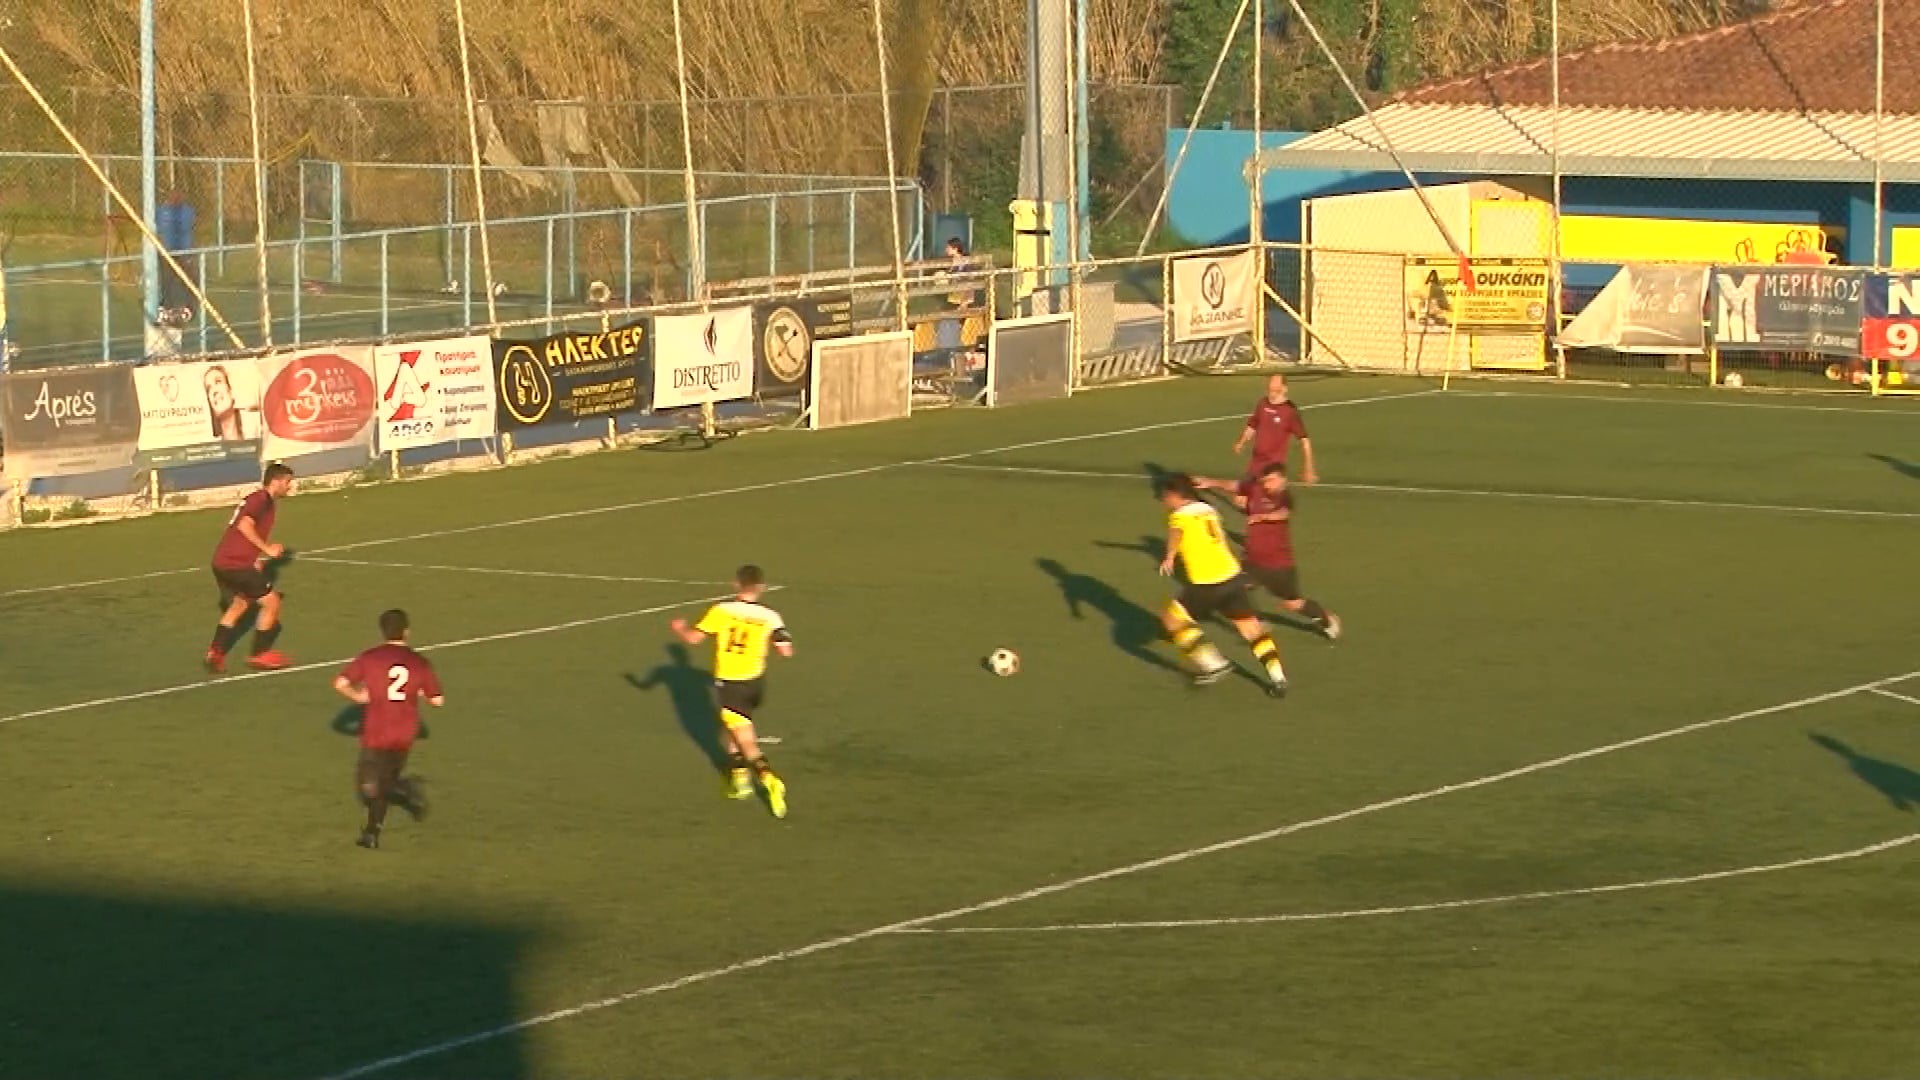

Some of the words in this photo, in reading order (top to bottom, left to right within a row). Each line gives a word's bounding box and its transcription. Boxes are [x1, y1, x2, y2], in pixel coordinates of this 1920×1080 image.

[1464, 268, 1546, 287] ουκάκη
[1886, 323, 1918, 357] 9
[386, 664, 410, 702] 2
